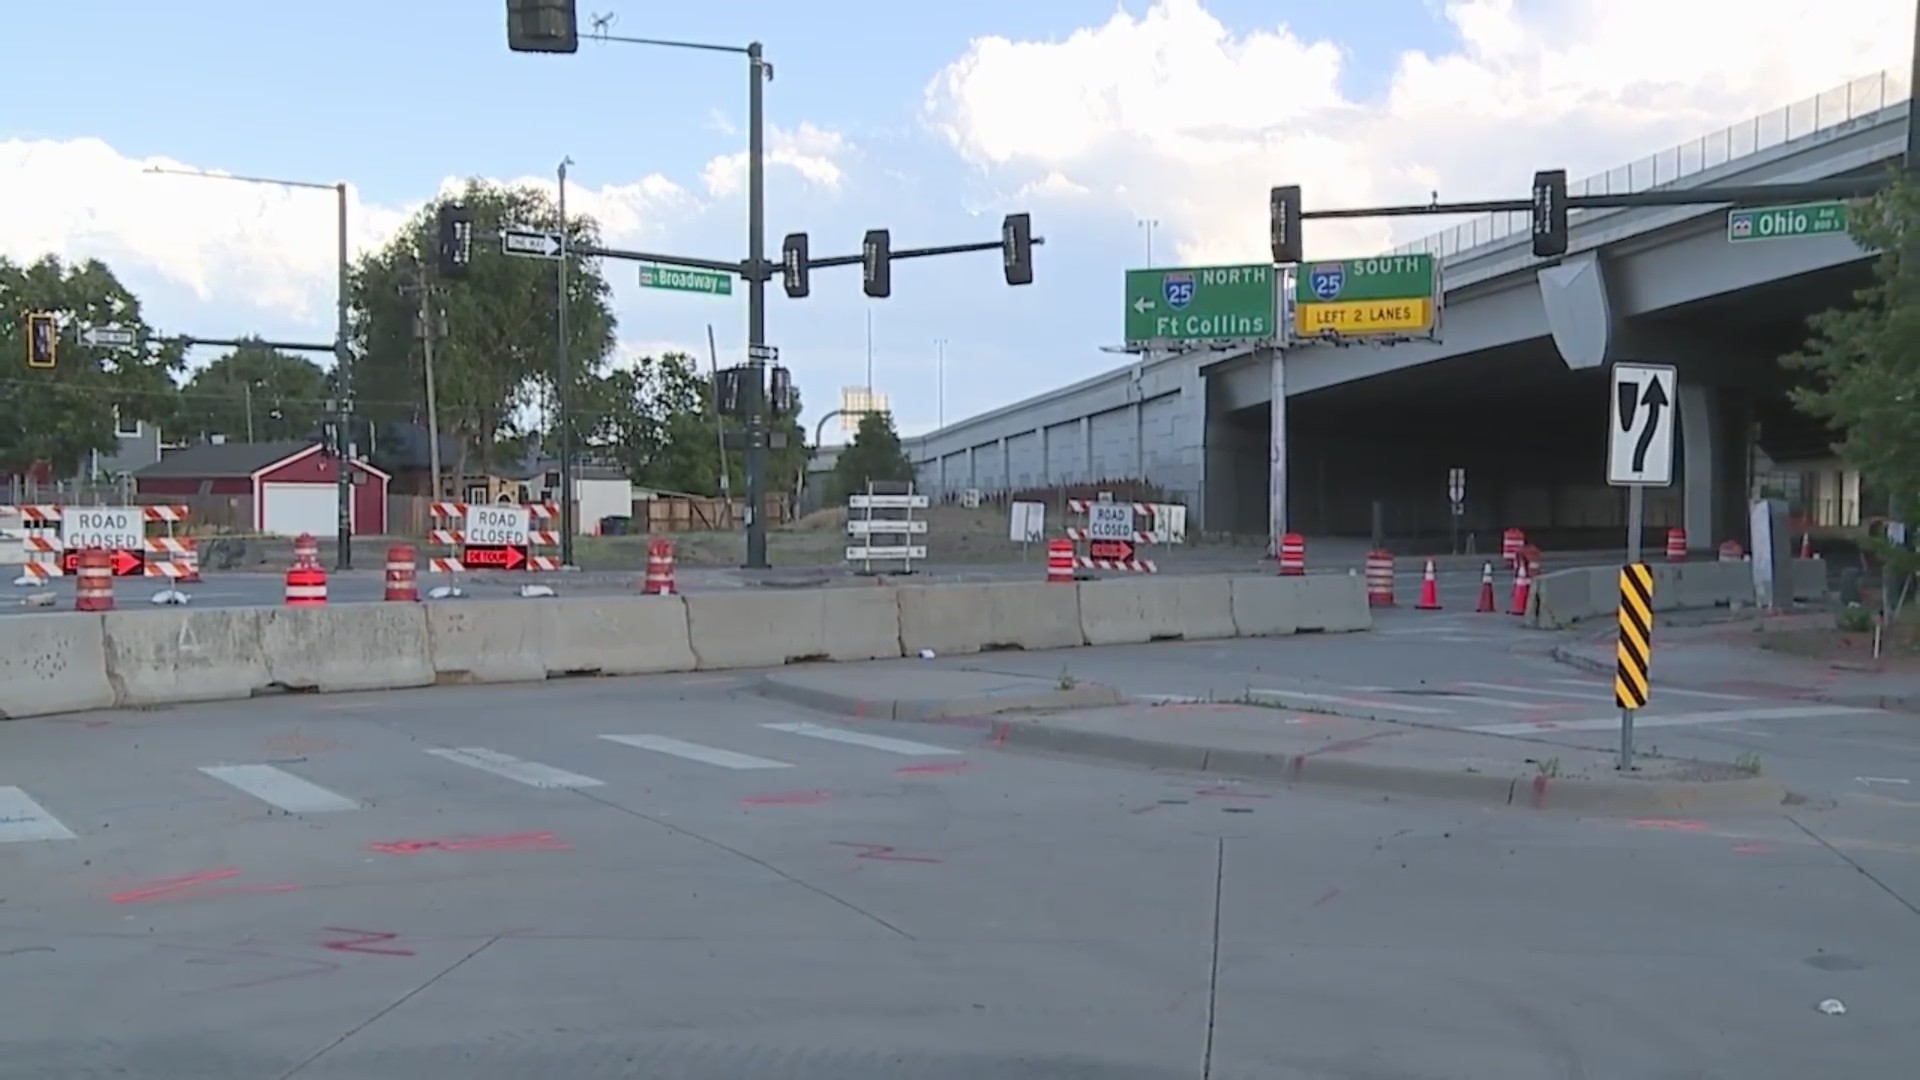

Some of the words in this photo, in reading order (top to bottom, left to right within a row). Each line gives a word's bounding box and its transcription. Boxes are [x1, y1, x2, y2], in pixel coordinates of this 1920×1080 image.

[1759, 210, 1807, 235] Ohio
[1353, 257, 1419, 276] SOUTH
[659, 269, 718, 293] Broadway
[1203, 268, 1266, 285] NORTH
[1317, 275, 1340, 294] 25
[1169, 284, 1191, 303] 25
[1316, 310, 1346, 324] LEFT
[1354, 309, 1362, 322] 2
[1370, 306, 1411, 322] LANES
[1157, 316, 1179, 336] Ft
[1186, 314, 1264, 335] Collins
[79, 513, 127, 529] ROAD
[480, 511, 517, 527] ROAD
[1097, 508, 1125, 521] ROAD
[471, 529, 523, 544] CLOSED
[1092, 523, 1130, 536] CLOSED
[70, 533, 137, 549] CLOSED
